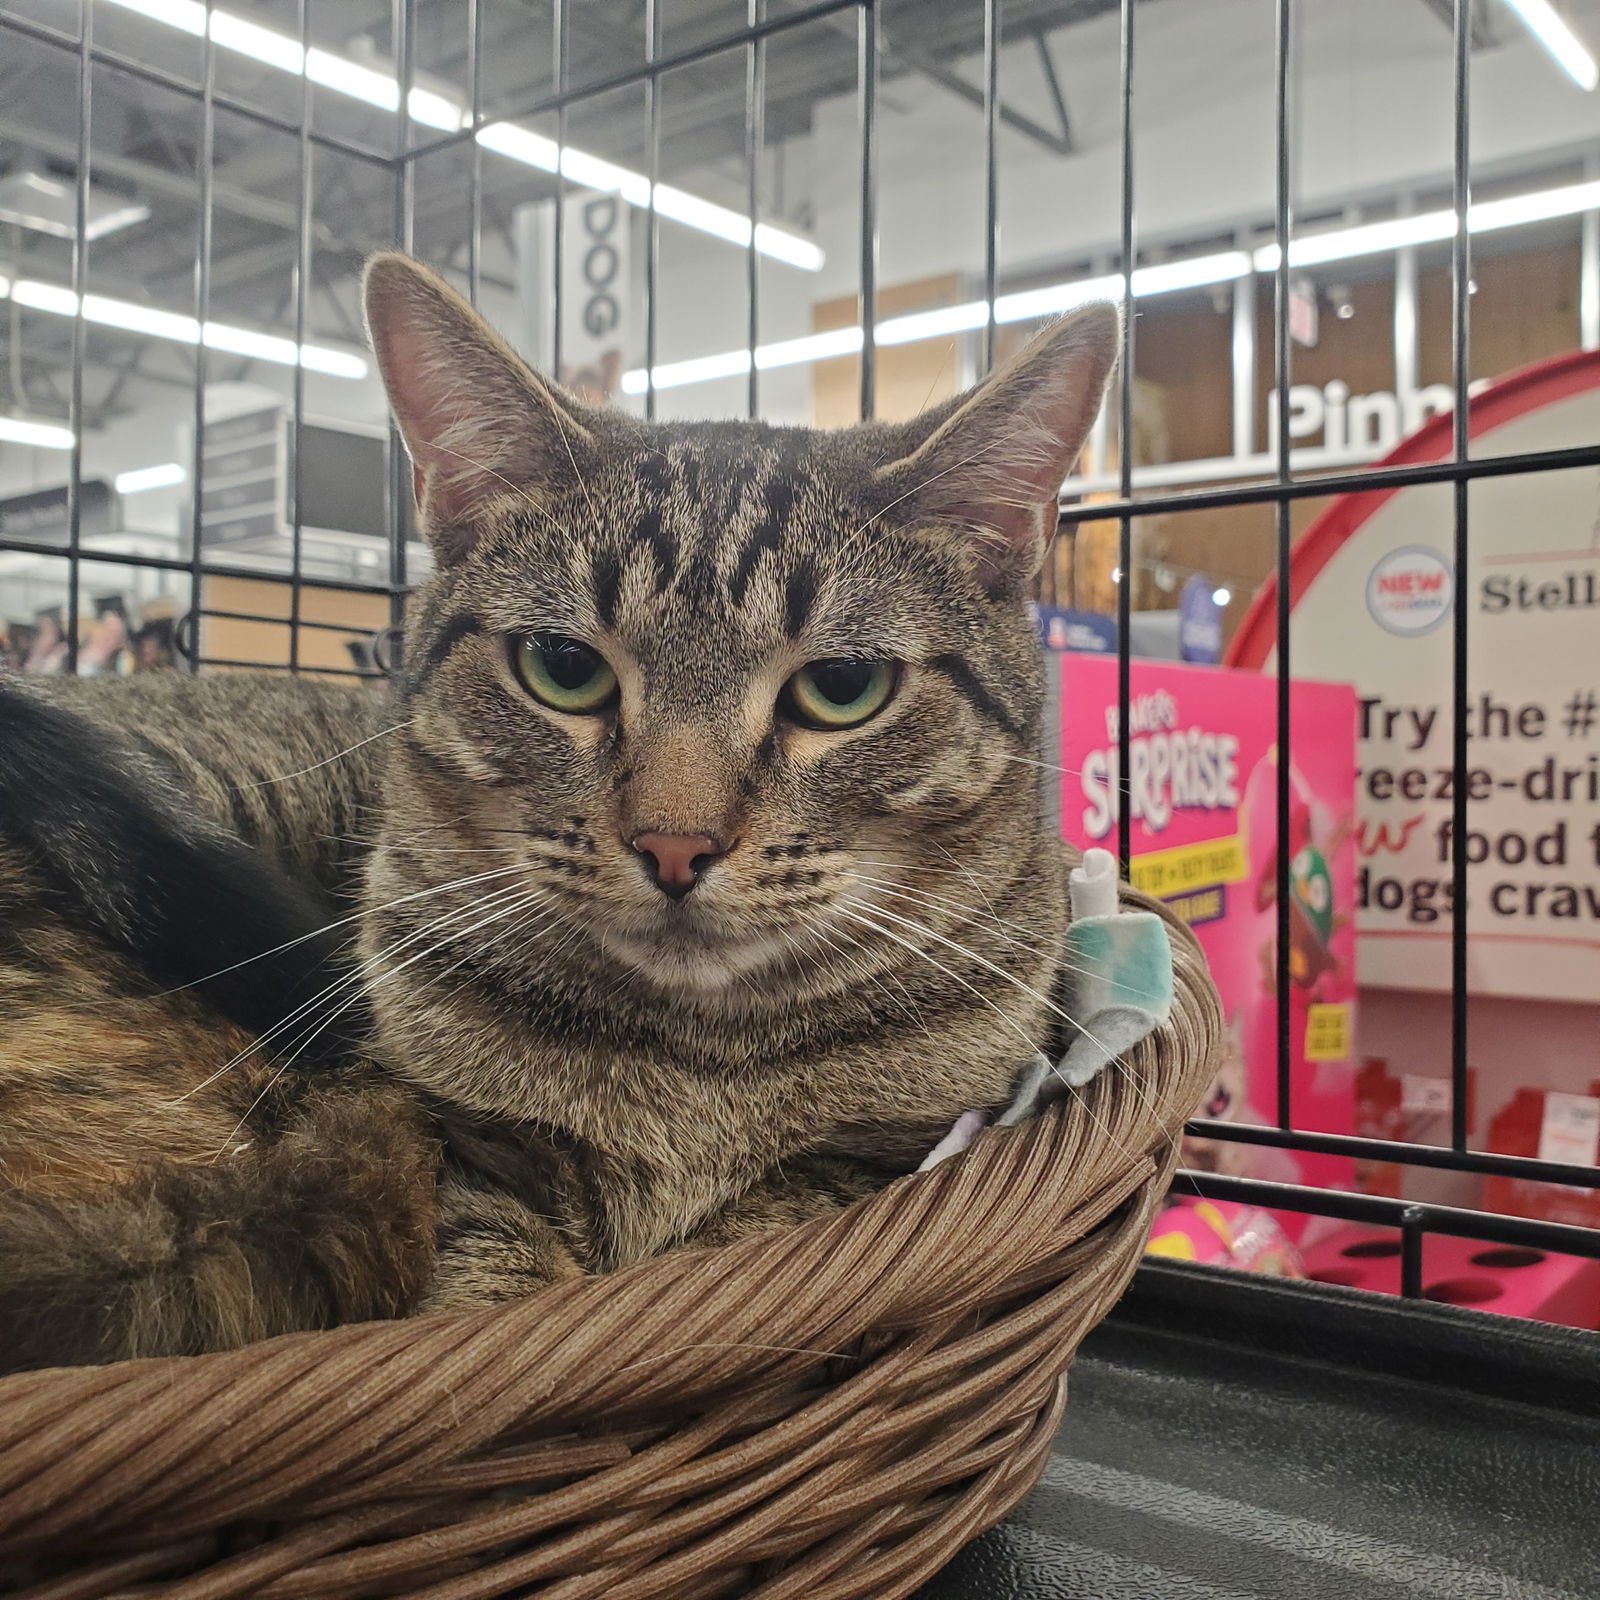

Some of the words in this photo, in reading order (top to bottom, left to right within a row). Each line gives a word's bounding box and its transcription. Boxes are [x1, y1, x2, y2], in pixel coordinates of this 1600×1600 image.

[582, 197, 620, 338] DOG
[1378, 571, 1445, 594] NEW
[1357, 697, 1437, 750] Try
[1355, 754, 1600, 801] eeze-dri
[1435, 819, 1567, 866] food
